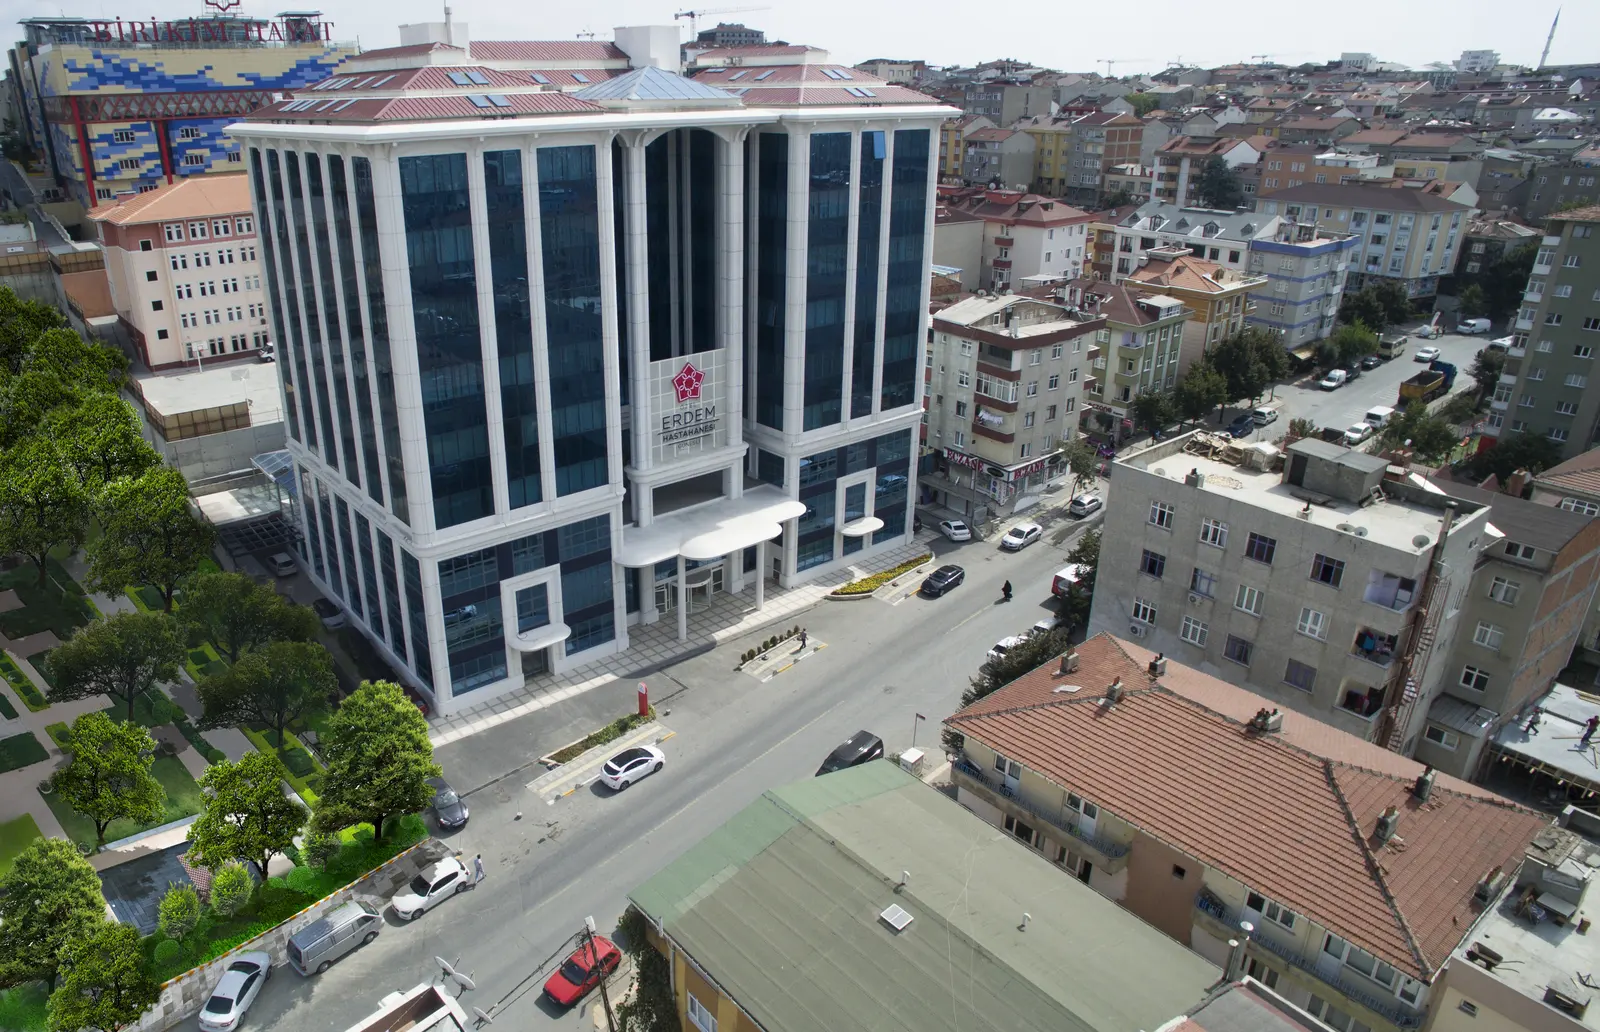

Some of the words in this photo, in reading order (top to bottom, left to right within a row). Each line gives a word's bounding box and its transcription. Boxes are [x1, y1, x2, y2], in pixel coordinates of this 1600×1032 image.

[93, 15, 230, 42] BİRİKİM
[243, 18, 335, 42] HAYAT
[662, 405, 716, 430] ERDEM
